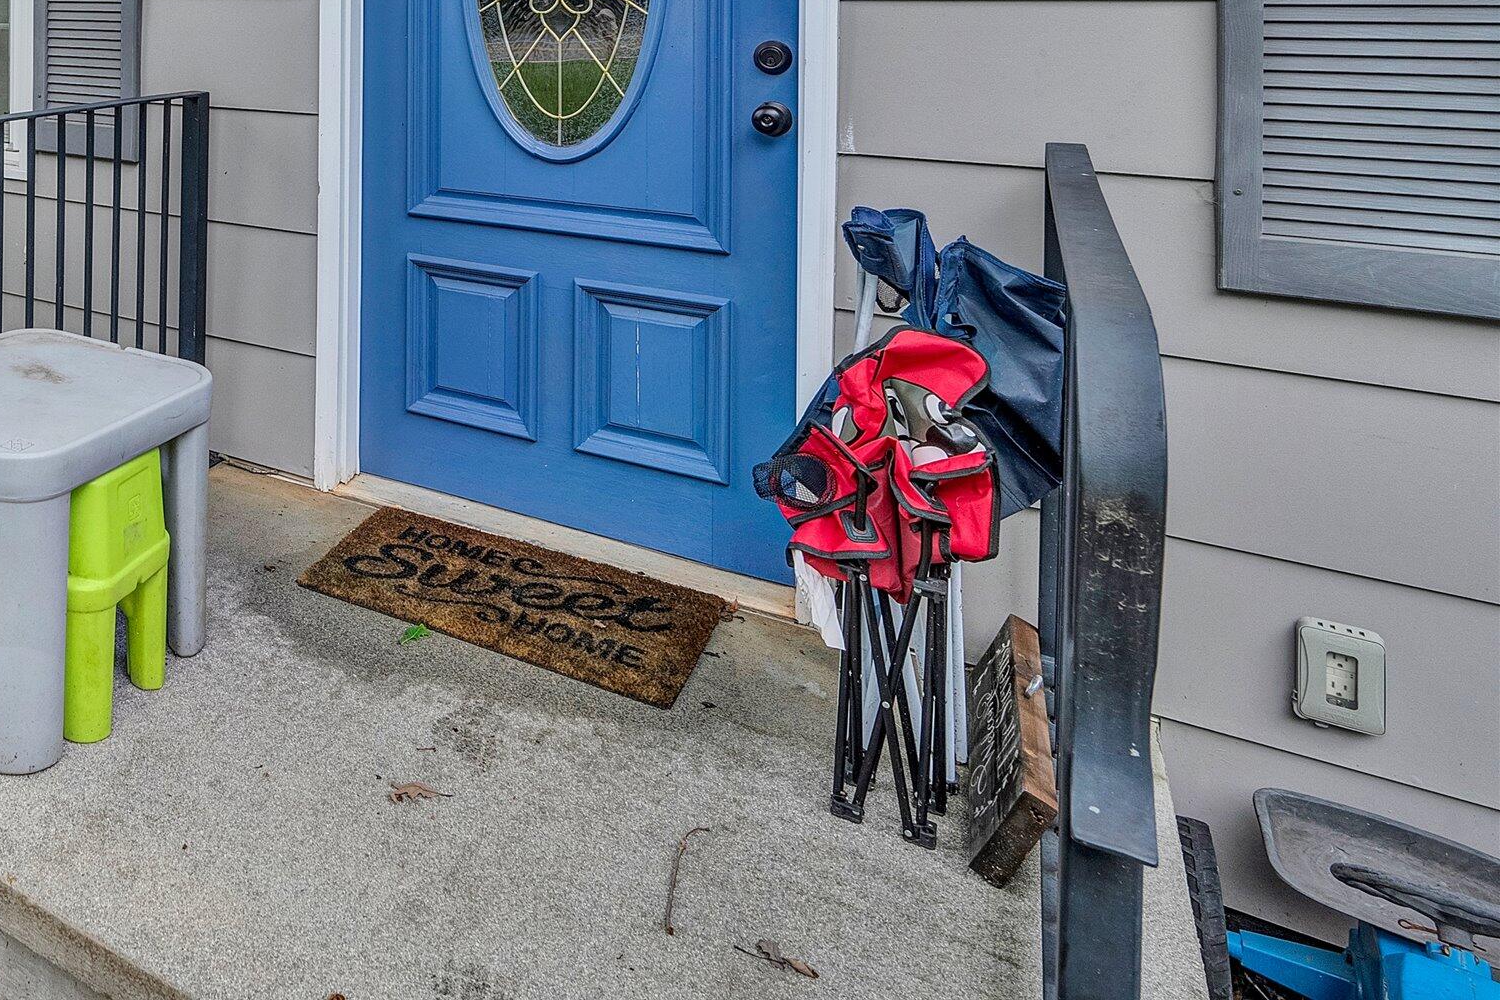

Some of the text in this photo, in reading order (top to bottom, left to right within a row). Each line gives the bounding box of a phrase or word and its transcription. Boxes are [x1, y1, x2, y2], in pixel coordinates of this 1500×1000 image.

[399, 525, 508, 566] HOME
[343, 544, 674, 632] Sweet
[513, 611, 647, 669] HOME
[970, 683, 1000, 796] Welcome
[996, 714, 1016, 779] The
